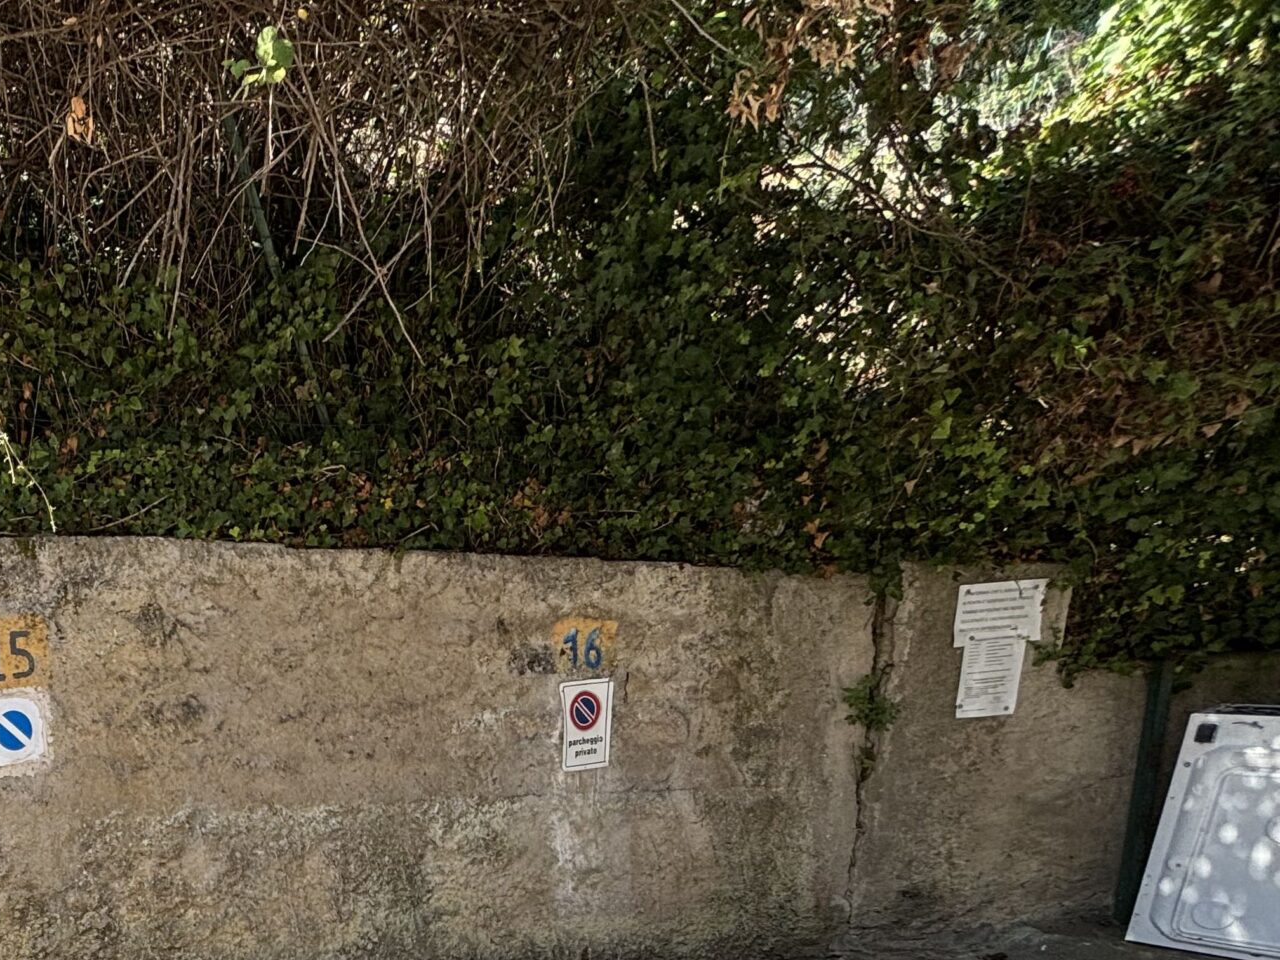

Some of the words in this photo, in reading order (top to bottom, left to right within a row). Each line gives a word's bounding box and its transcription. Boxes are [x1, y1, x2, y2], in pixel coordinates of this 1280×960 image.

[563, 627, 602, 669] 16
[568, 734, 603, 748] parcheggio
[575, 748, 598, 758] privato
